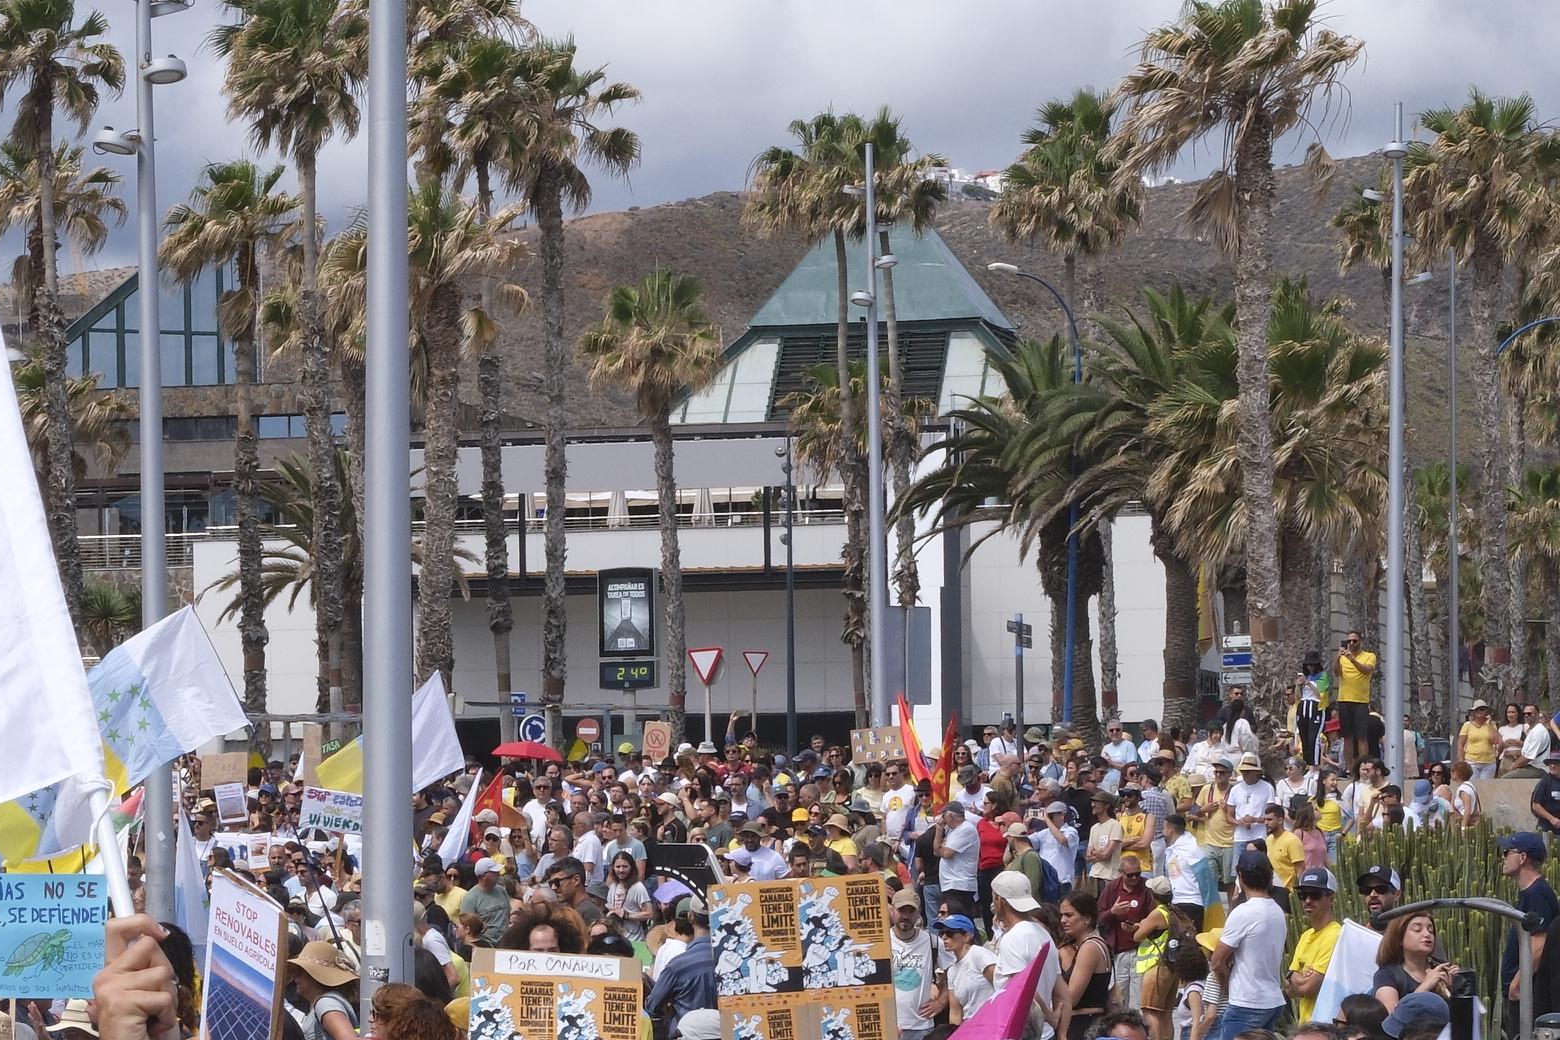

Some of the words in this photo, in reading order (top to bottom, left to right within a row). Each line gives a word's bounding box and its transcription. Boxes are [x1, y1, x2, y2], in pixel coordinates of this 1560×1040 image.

[309, 813, 362, 831] VIVIEND
[44, 881, 65, 900] NO
[76, 881, 98, 899] SE
[846, 886, 879, 895] CANARIAS
[759, 894, 793, 903] CANARIAS
[847, 896, 868, 907] TIENE
[870, 895, 880, 905] UN
[235, 901, 258, 923] STOP
[760, 904, 782, 914] TIENE
[783, 903, 794, 913] UN
[8, 907, 27, 924] SE
[215, 907, 276, 957] RENOVABLES
[214, 925, 222, 937] EN
[223, 932, 244, 951] SUELO
[82, 952, 92, 960] ES
[509, 954, 537, 971] POR
[545, 957, 613, 977] CANARIAS
[521, 987, 553, 995] CANARIAS
[521, 996, 542, 1006] TIENE
[543, 997, 554, 1007] UN
[604, 993, 637, 1002] CANARIAS
[603, 1002, 625, 1012] TIENE
[626, 1003, 637, 1013] UN
